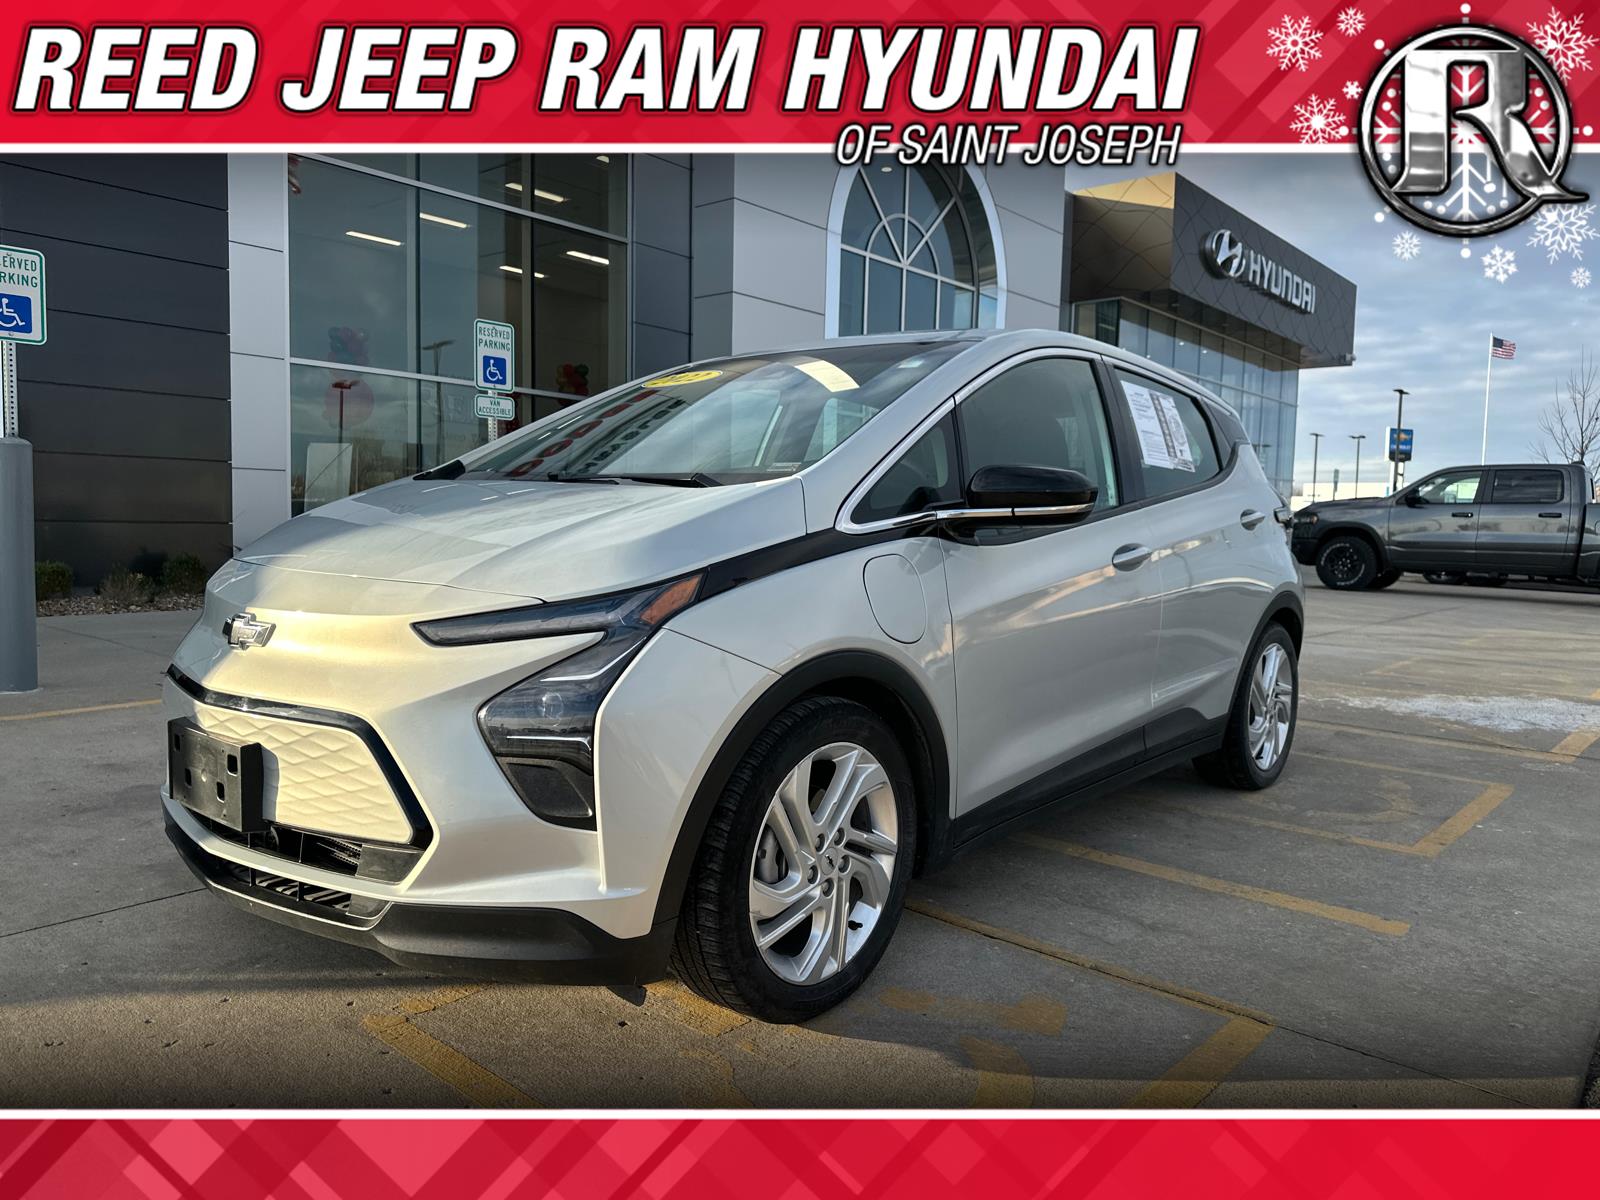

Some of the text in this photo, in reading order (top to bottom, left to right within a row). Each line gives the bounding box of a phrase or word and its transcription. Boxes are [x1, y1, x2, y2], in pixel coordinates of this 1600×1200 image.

[0, 255, 37, 272] ERVED
[1248, 249, 1316, 314] HYUNDAI
[478, 326, 511, 341] RESERVED
[478, 338, 511, 352] PARKING
[489, 399, 501, 408] VAN
[478, 406, 512, 417] ACCESSIBLE
